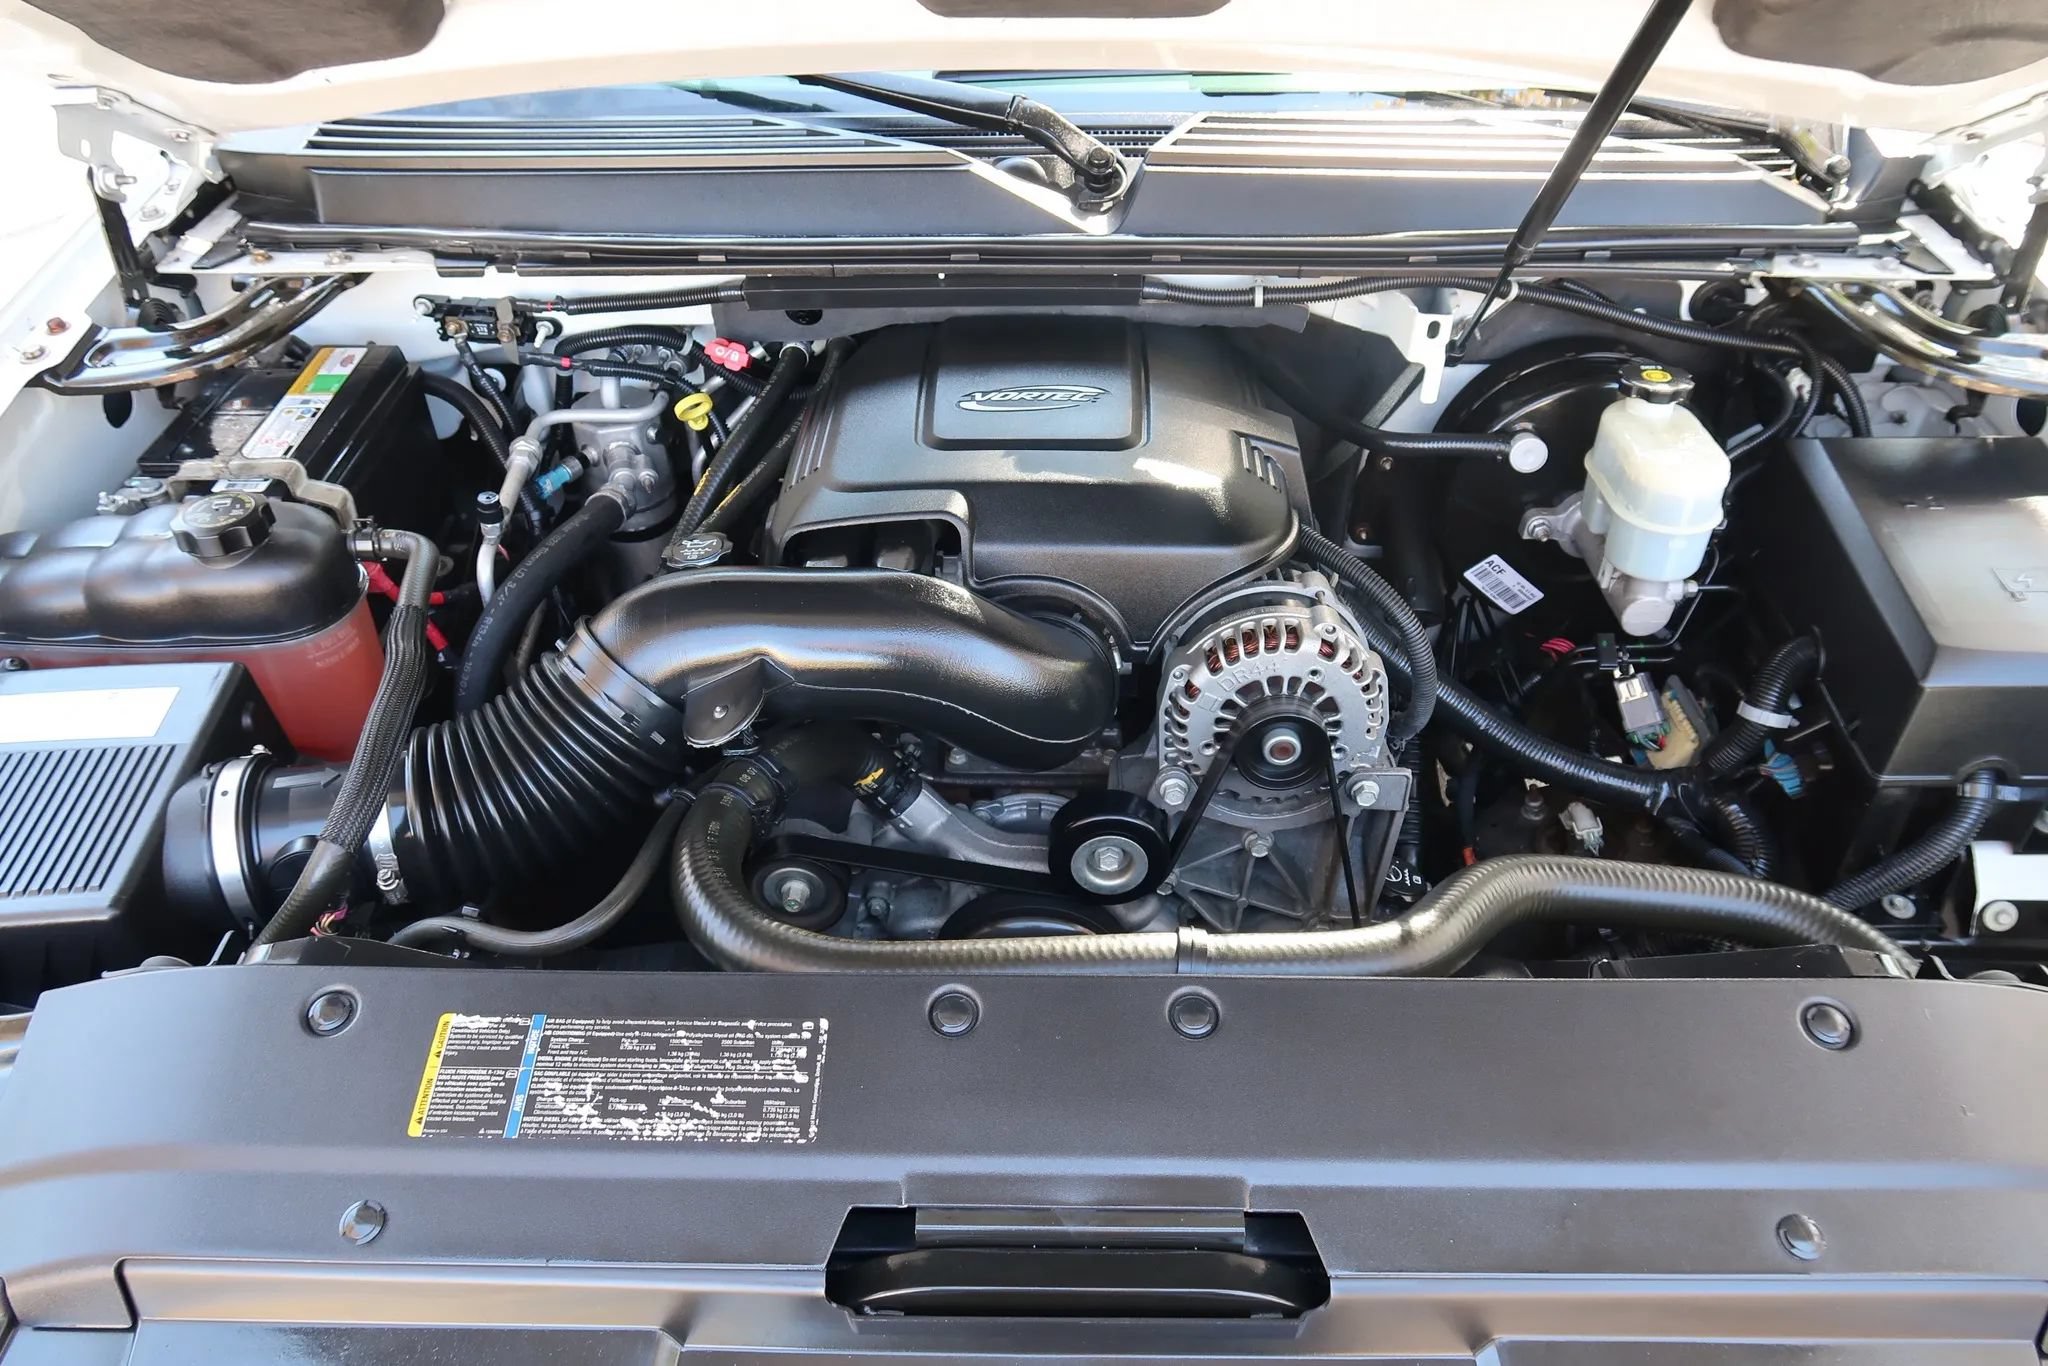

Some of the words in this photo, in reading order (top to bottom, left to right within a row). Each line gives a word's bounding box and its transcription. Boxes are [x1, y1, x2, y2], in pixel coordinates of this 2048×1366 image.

[972, 391, 1100, 402] VORTEC
[1485, 559, 1507, 575] ACF
[437, 1020, 450, 1049] CAUTION
[418, 1078, 433, 1115] ATTENTION
[513, 1094, 525, 1112] AVIS
